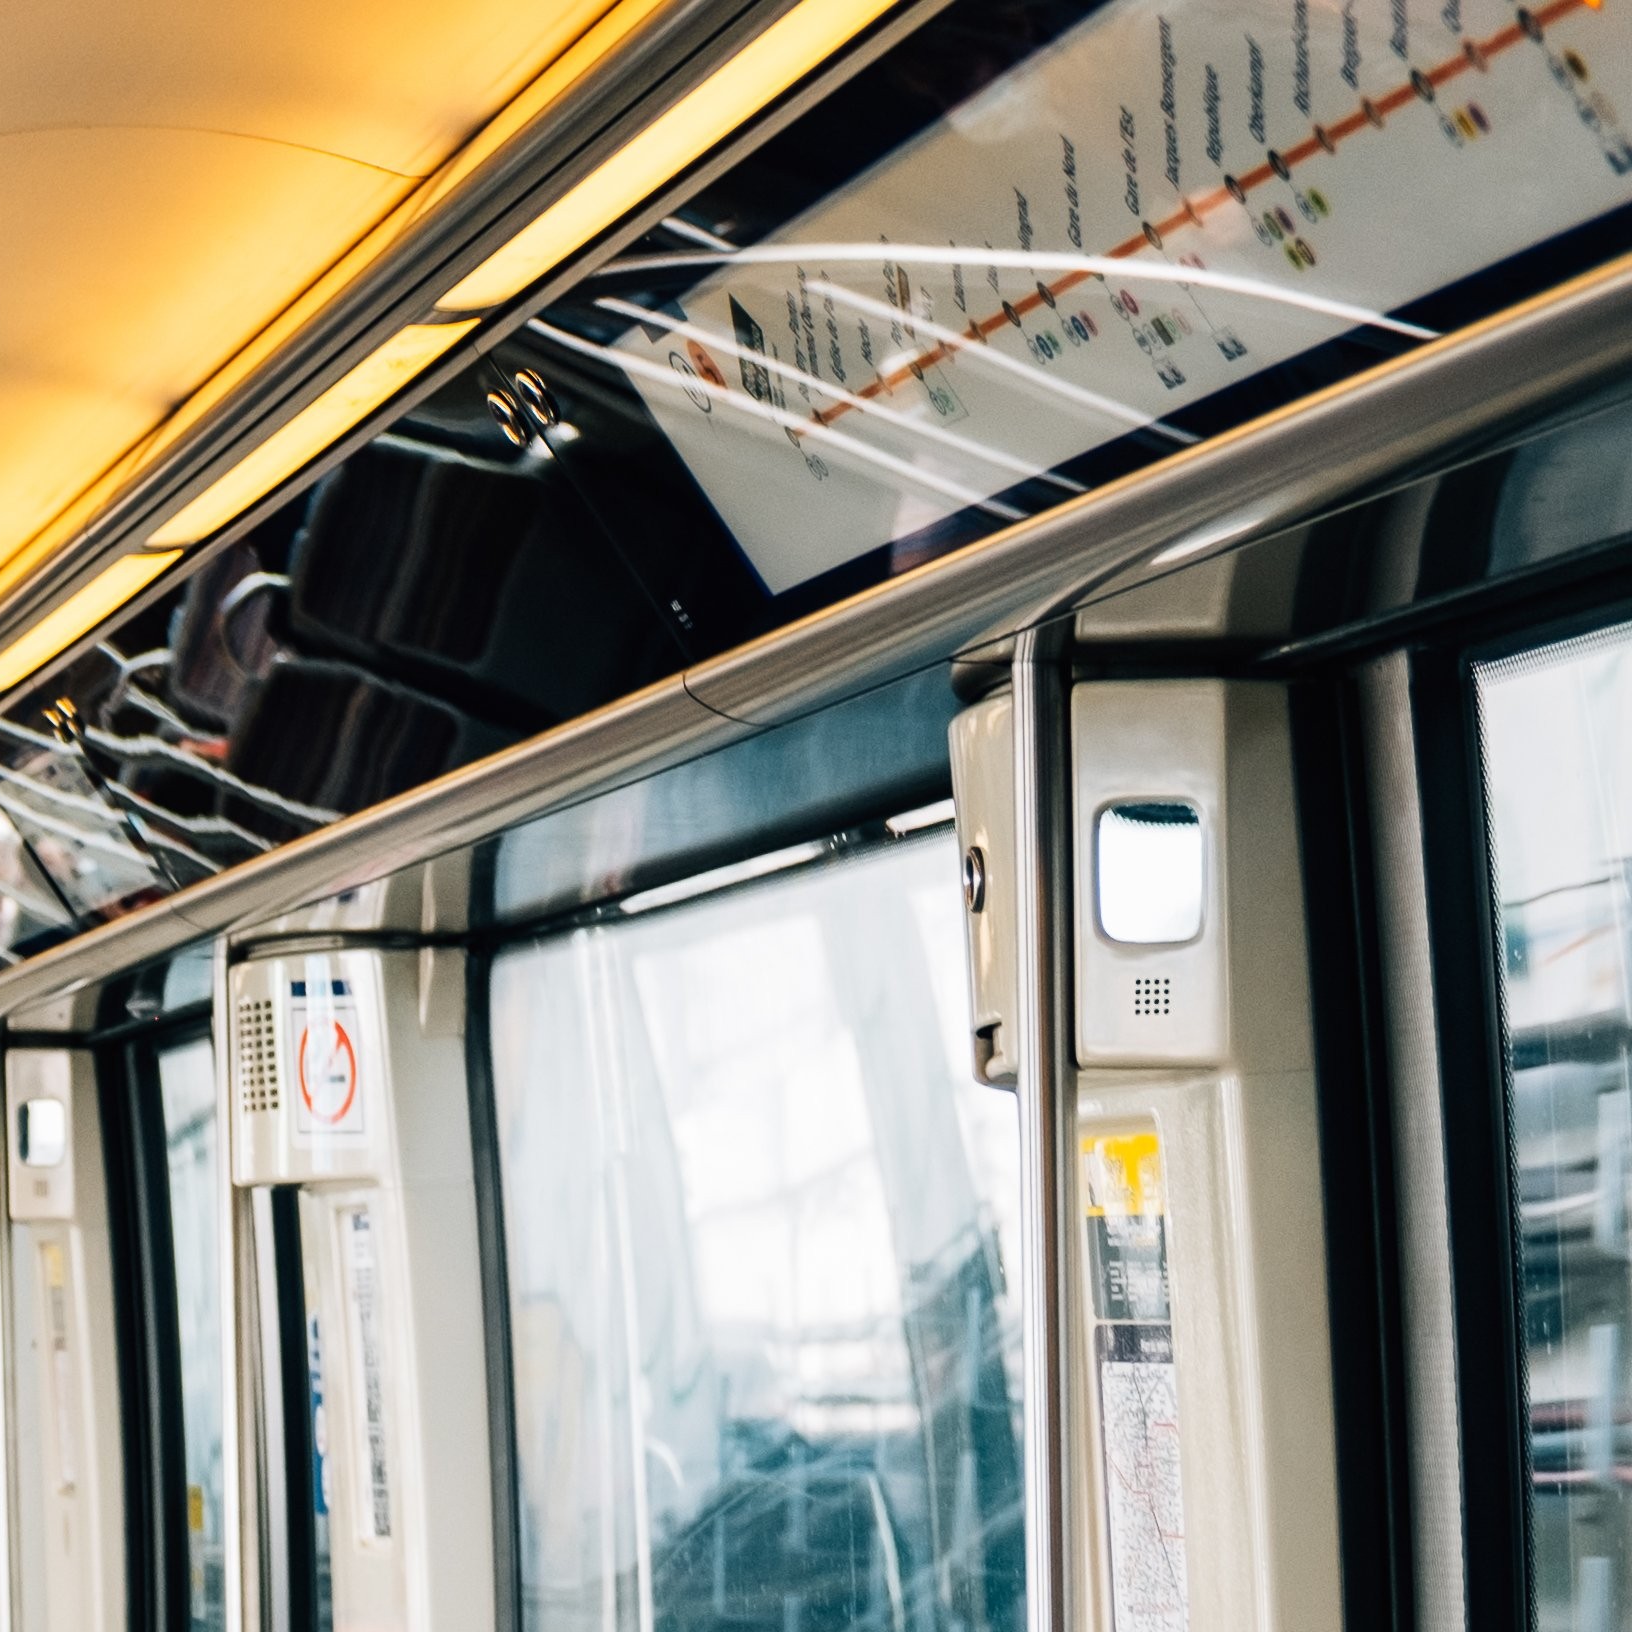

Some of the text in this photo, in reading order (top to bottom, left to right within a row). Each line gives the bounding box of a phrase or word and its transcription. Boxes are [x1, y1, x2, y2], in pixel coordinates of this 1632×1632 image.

[1202, 62, 1224, 169] République
[1058, 132, 1083, 249] Gare du Nord
[1122, 149, 1137, 174] de
[1164, 119, 1181, 191] Jacques
[1124, 173, 1141, 218] Gare
